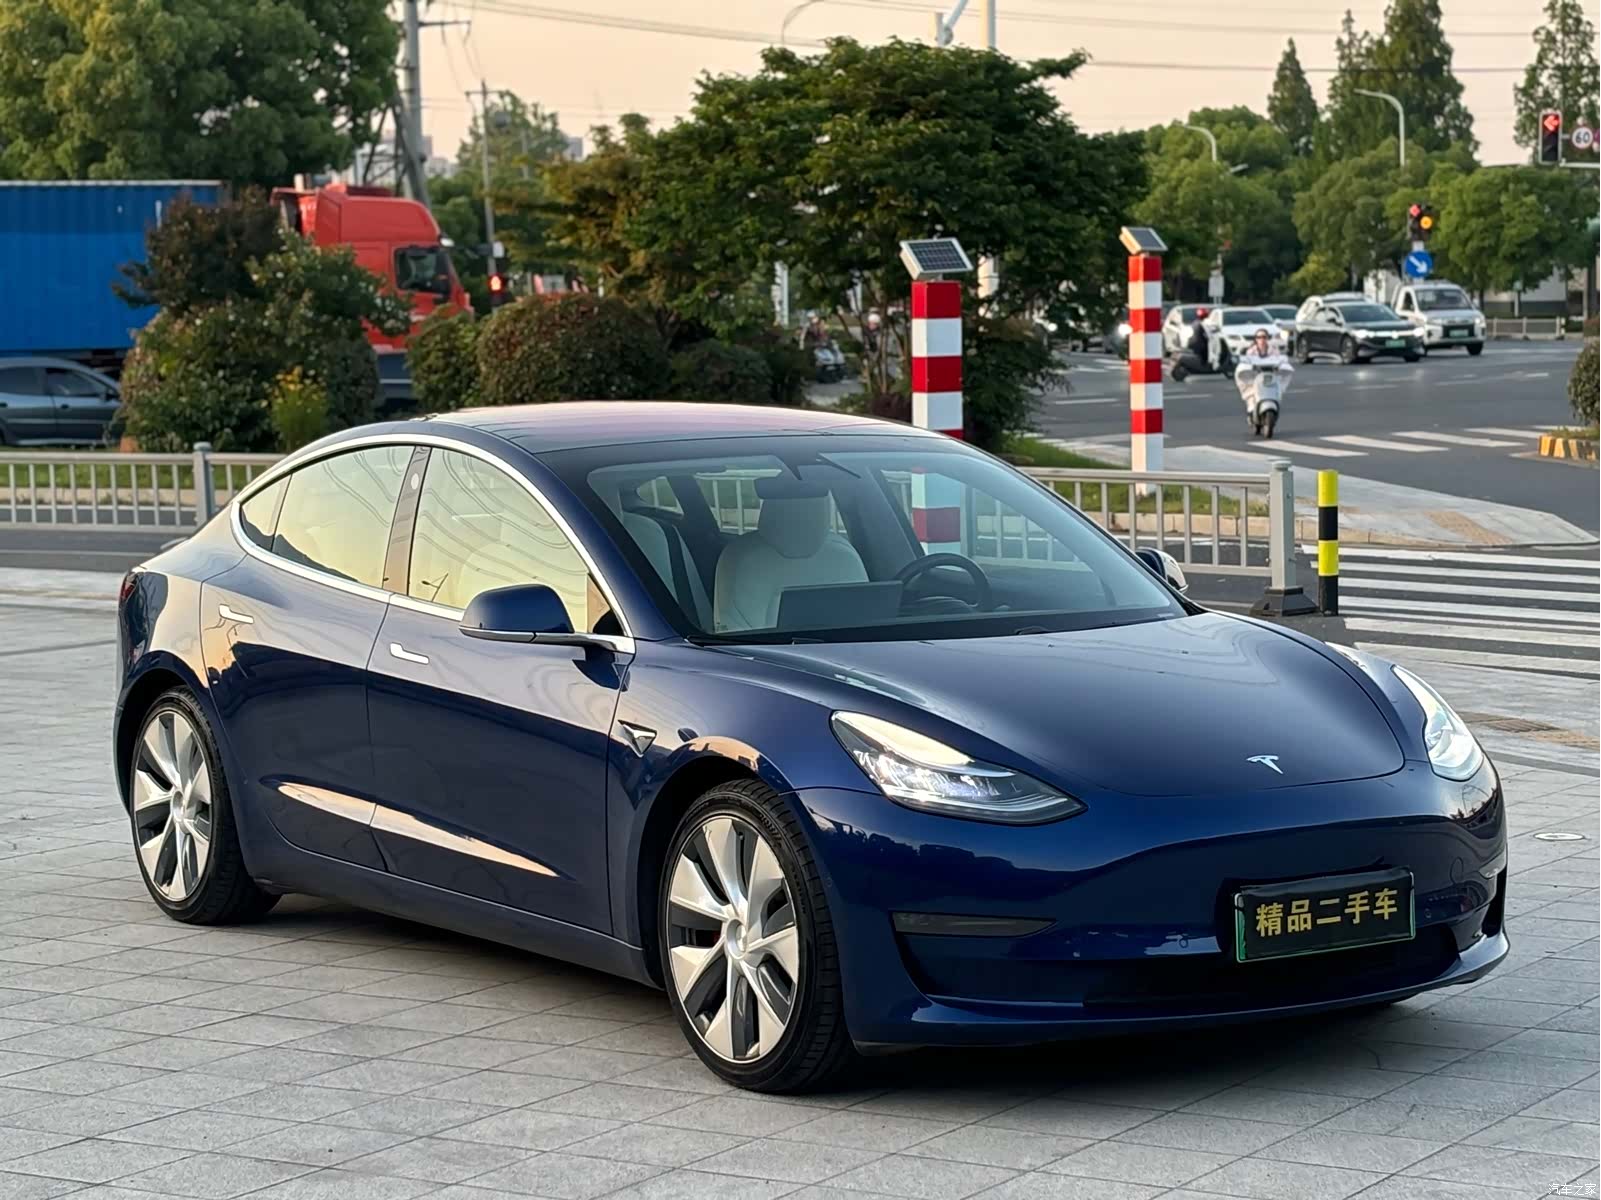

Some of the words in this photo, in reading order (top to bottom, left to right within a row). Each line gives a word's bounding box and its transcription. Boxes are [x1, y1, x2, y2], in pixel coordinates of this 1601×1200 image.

[1575, 131, 1590, 144] 60
[1256, 888, 1398, 937] 精品二手车
